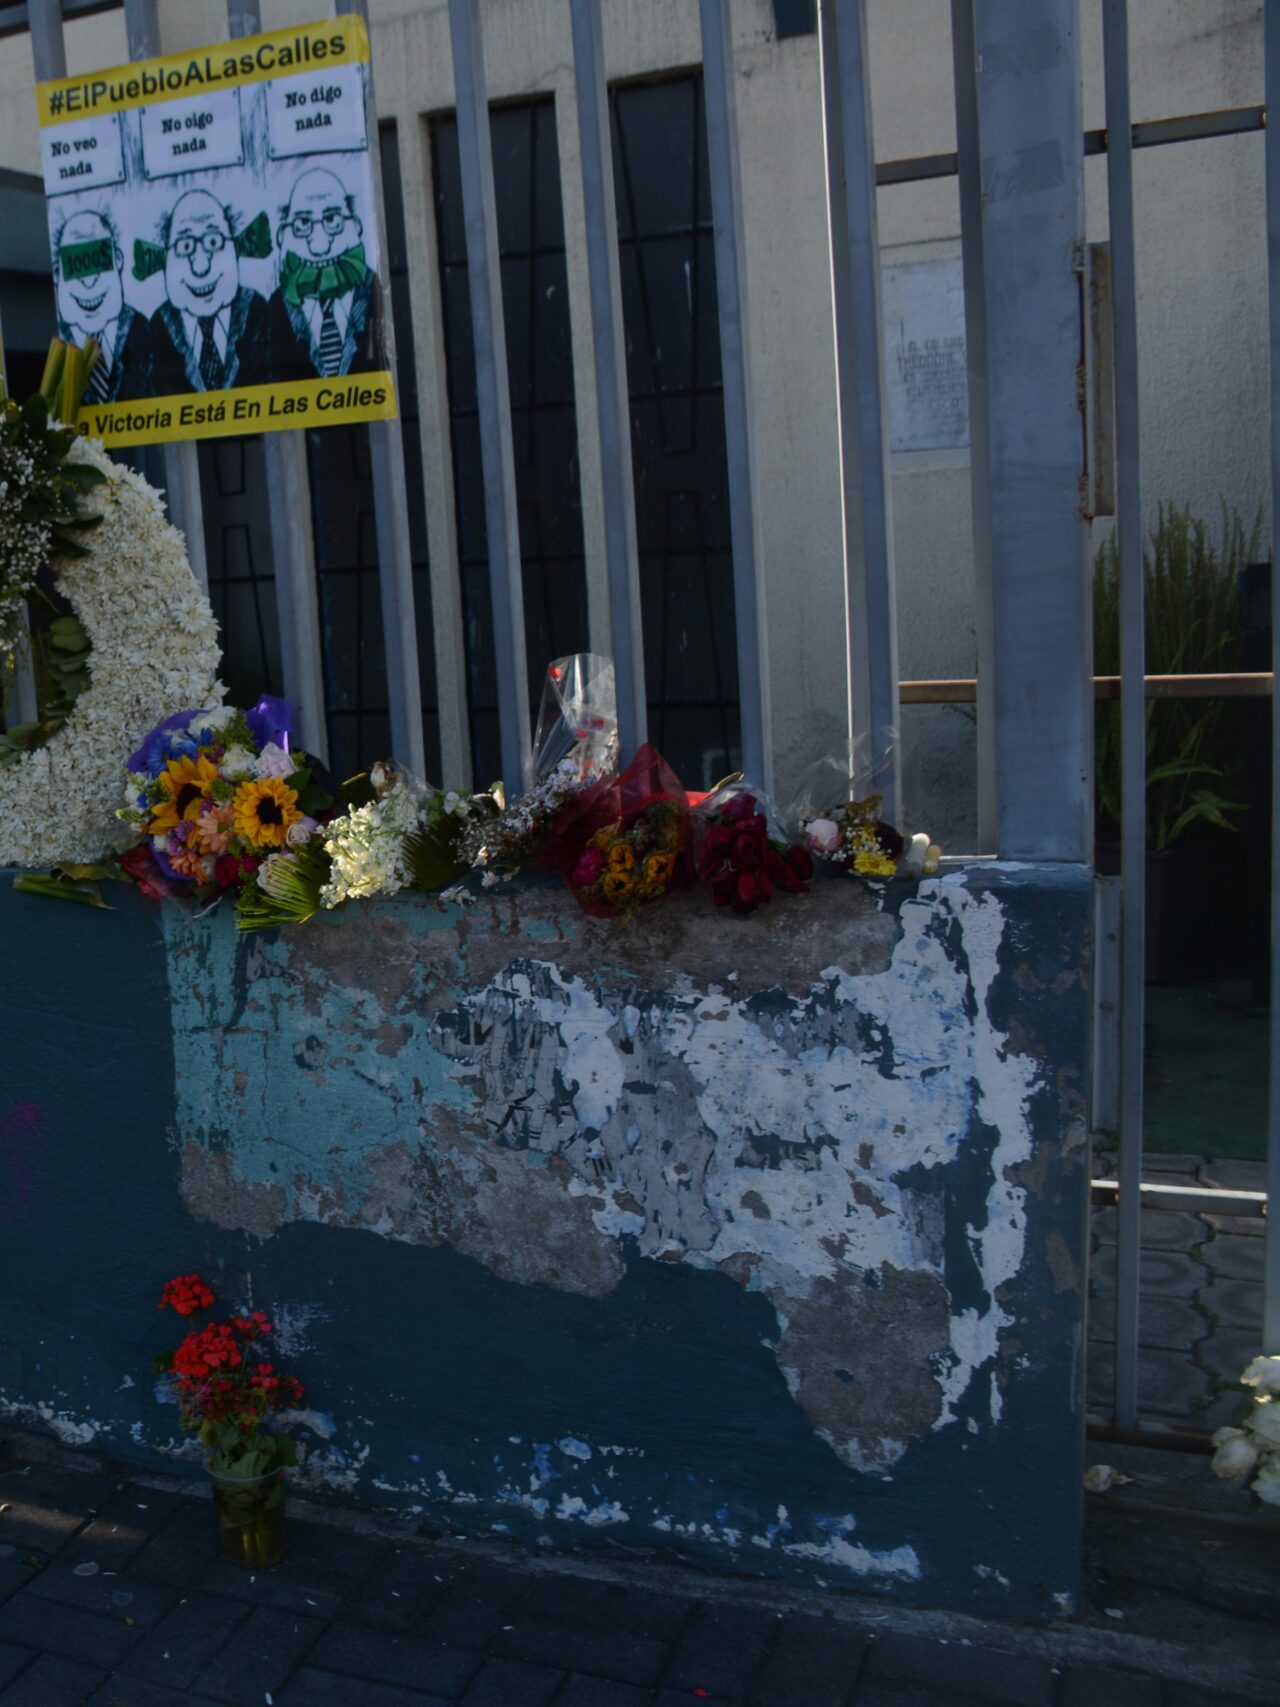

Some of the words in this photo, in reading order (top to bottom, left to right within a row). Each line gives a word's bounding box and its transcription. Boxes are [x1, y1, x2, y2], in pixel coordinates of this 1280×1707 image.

[47, 32, 346, 116] #ElPuebloALasCalles
[285, 90, 308, 108] No
[310, 84, 342, 105] digo
[161, 118, 182, 133] No
[184, 112, 213, 131] oigo
[295, 113, 332, 131] nada
[50, 142, 70, 157] No
[72, 136, 97, 151] veo
[172, 137, 207, 156] nada
[59, 161, 93, 179] nada
[96, 408, 172, 434] Victoria
[179, 400, 226, 425] Está
[233, 396, 260, 420] En
[269, 390, 308, 415] Las
[316, 385, 387, 411] Calles
